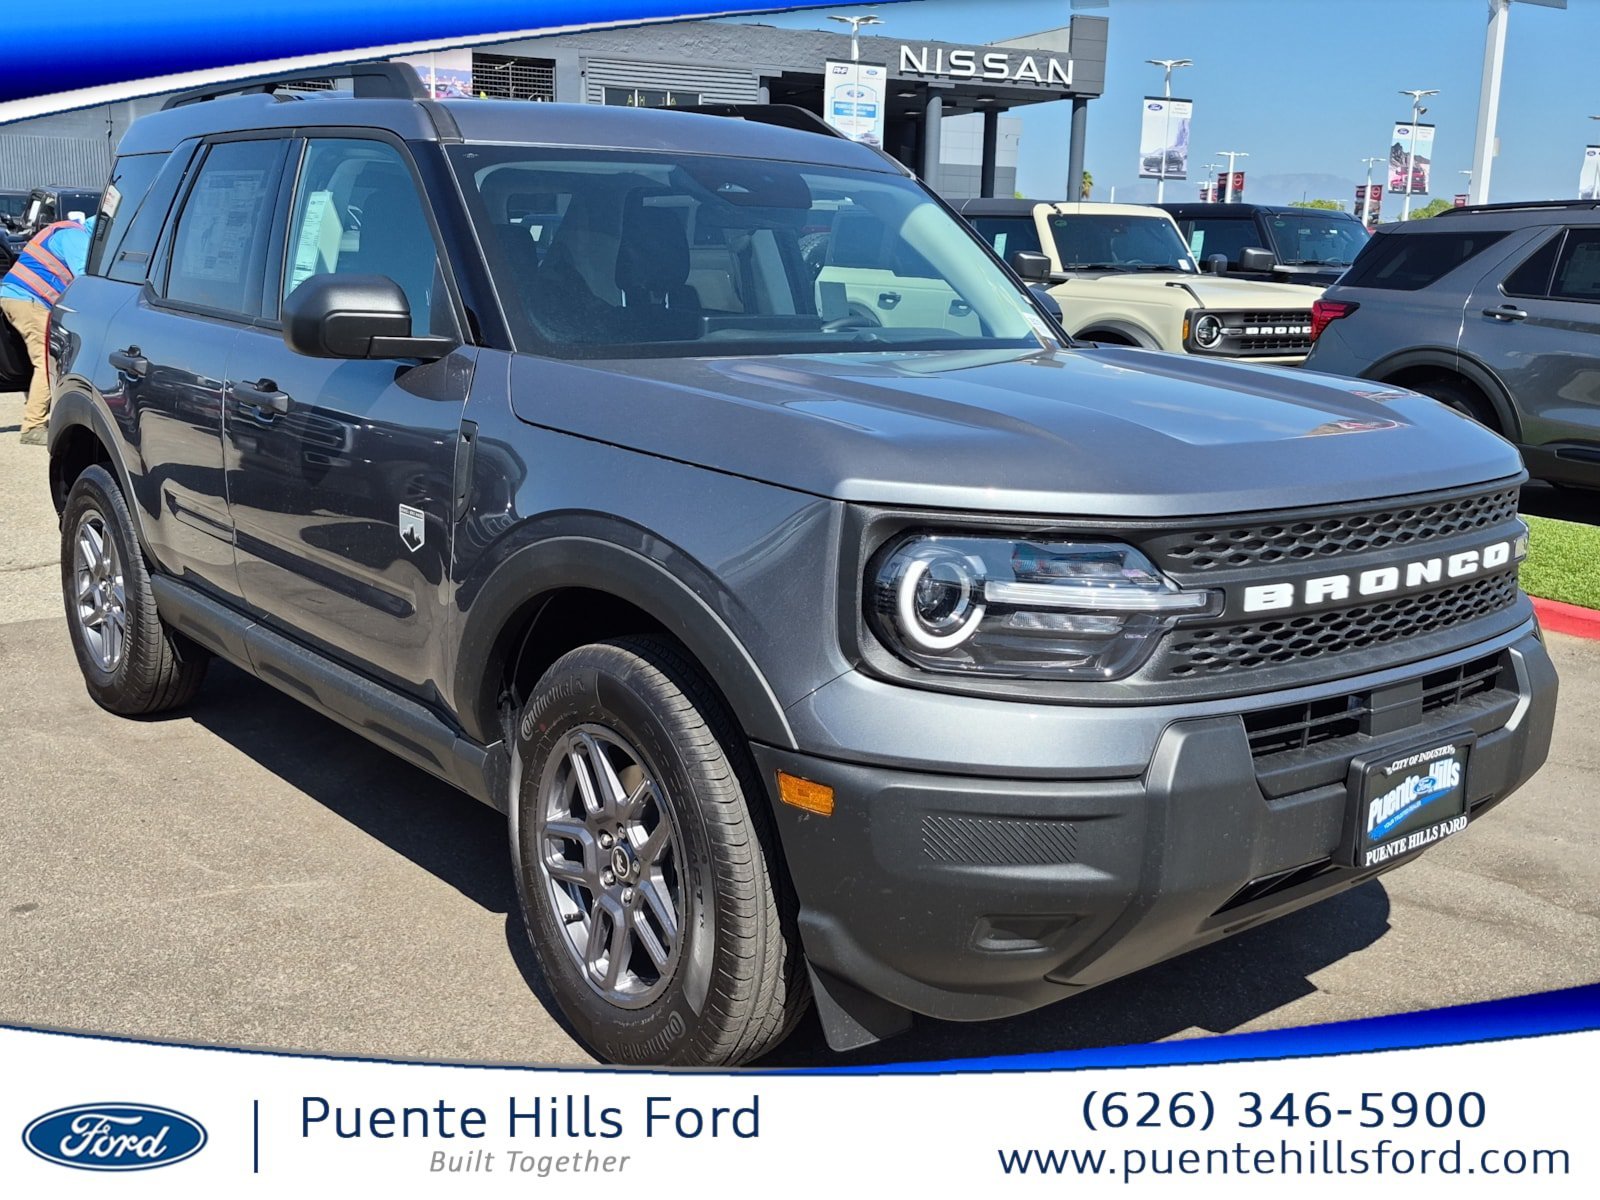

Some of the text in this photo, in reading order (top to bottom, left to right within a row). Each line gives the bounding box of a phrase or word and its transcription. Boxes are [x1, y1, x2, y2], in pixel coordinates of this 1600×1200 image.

[899, 45, 1074, 85] NISSAN
[1245, 326, 1313, 335] BRONC
[1243, 541, 1510, 612] BRONCO
[521, 675, 574, 741] Continental
[1391, 744, 1453, 772] CITY OF INDUSTRY
[1367, 775, 1420, 833] Puente
[1428, 758, 1461, 792] Hills
[1365, 837, 1407, 867] PUENTE
[1407, 826, 1439, 850] HILLS
[1440, 815, 1468, 838] FORD
